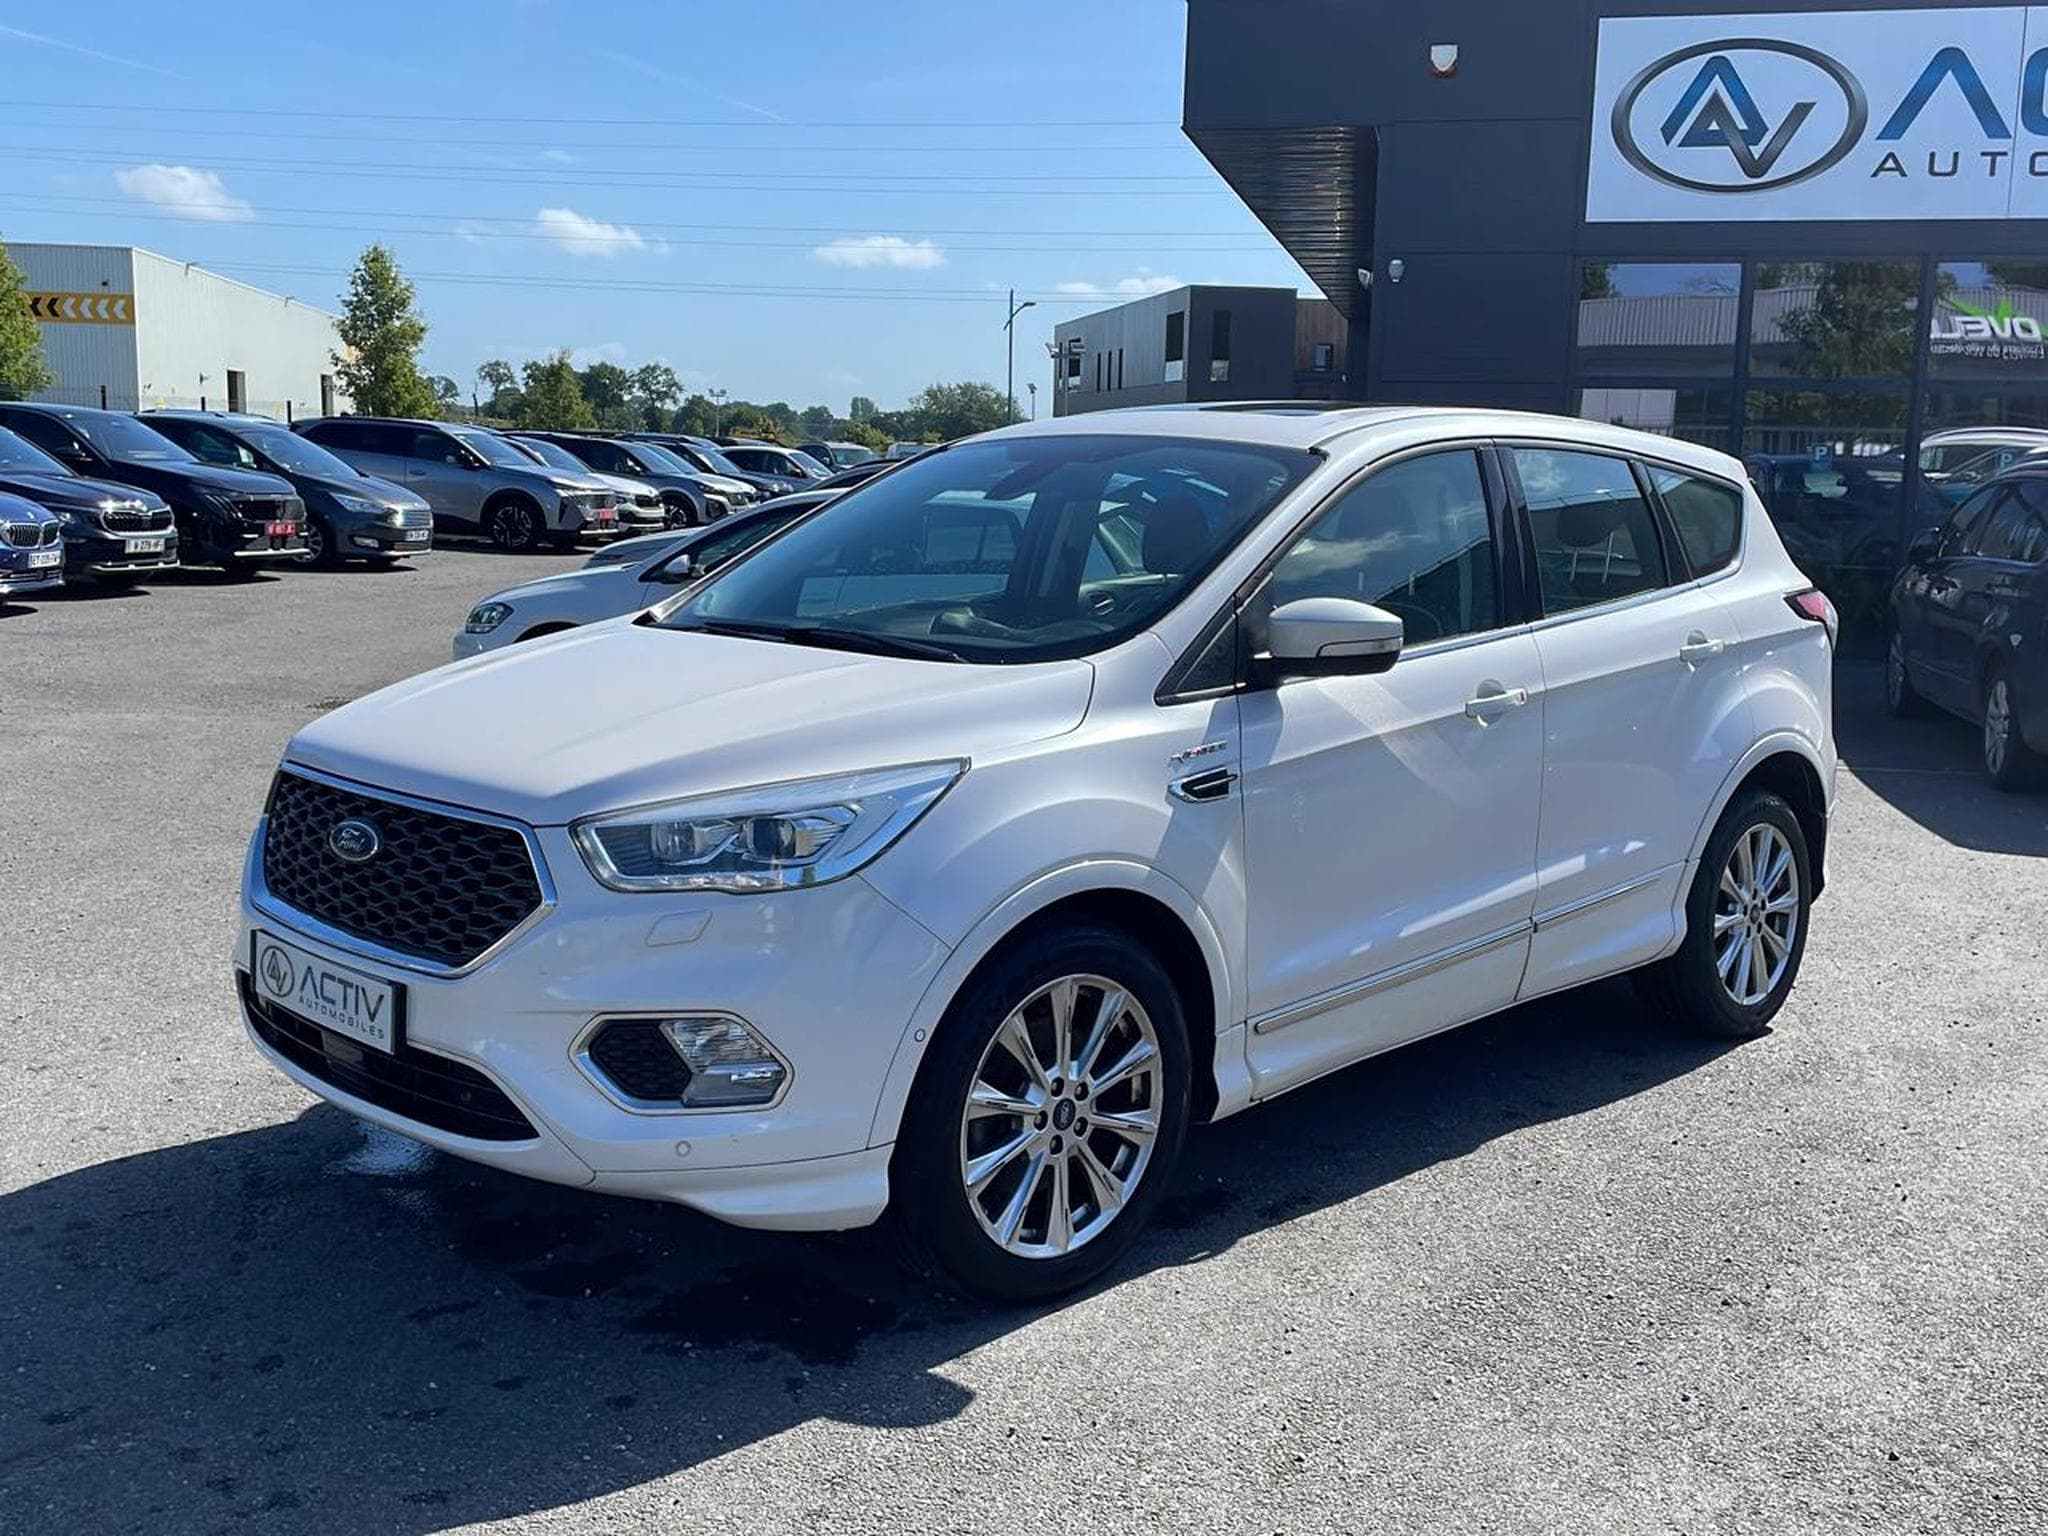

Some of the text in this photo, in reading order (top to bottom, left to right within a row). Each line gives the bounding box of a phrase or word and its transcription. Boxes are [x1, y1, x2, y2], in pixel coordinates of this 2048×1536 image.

[1814, 446, 1828, 461] P
[2000, 453, 2013, 469] P
[300, 964, 385, 1023] ACTIV
[299, 996, 385, 1040] AUTOMOBILES
